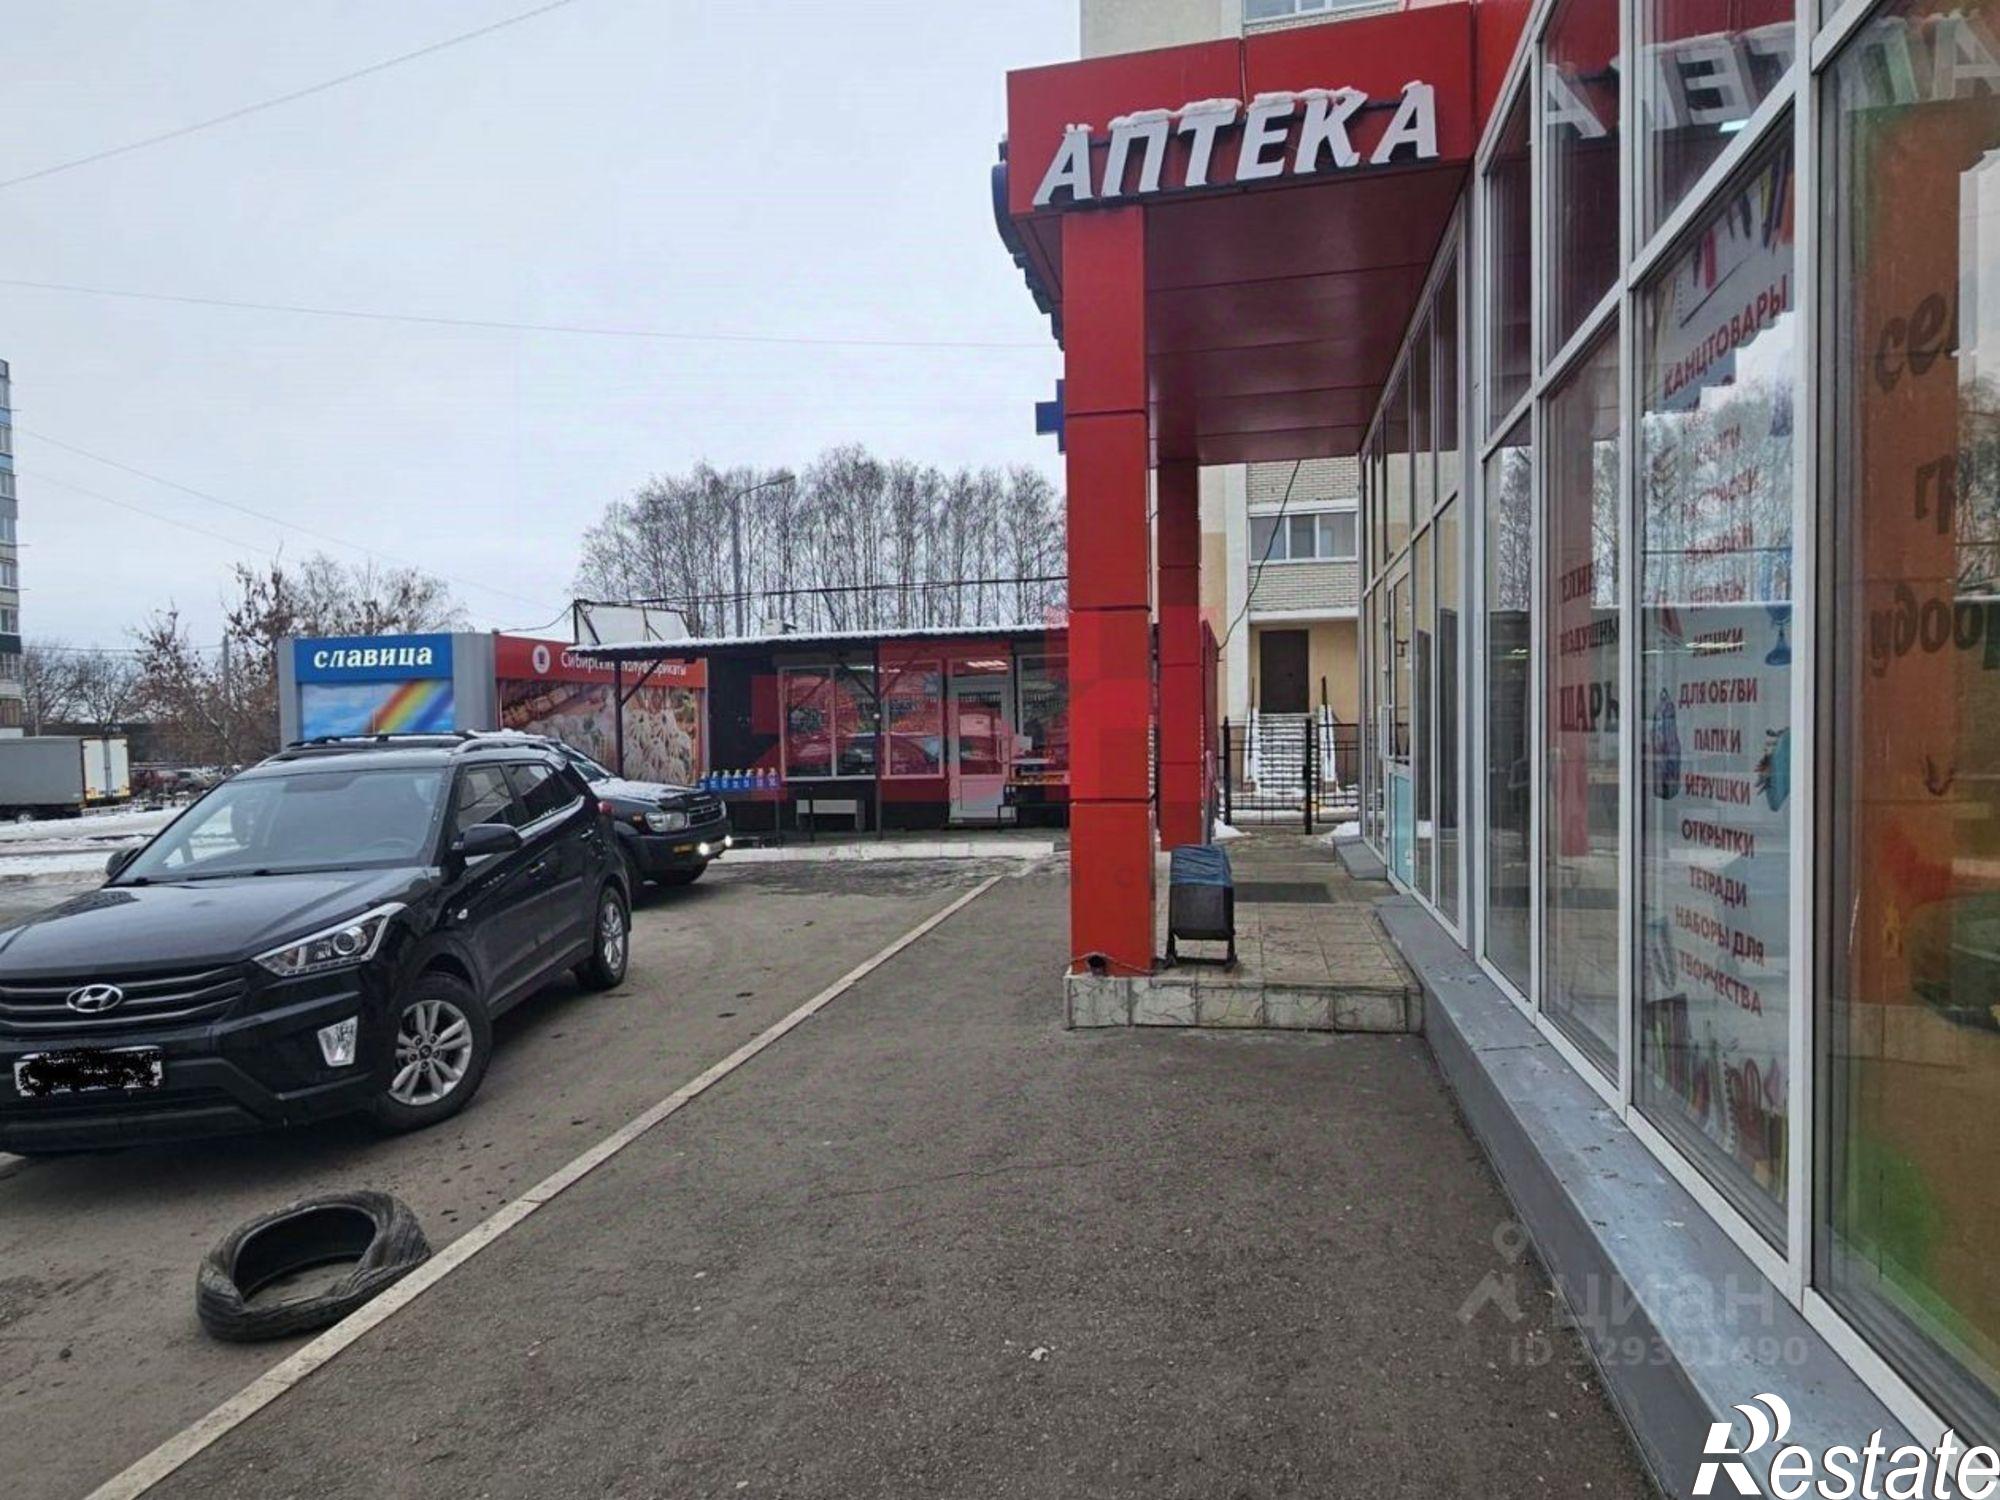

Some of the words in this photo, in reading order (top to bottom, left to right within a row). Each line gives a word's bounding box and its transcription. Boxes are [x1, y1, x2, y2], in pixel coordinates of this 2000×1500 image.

[1032, 82, 1440, 206] АПТЕКА
[1663, 274, 1788, 401] КАНЦТОВАРЫ
[313, 647, 433, 669] славица
[1694, 729, 1741, 755] ПАПКИ
[1684, 773, 1751, 806] ИГРУШКИ
[1682, 818, 1755, 860] ОТКРЫТКИ
[1689, 865, 1747, 909] ТЕТРАДИ
[1675, 905, 1730, 950] НАБОРЫ
[1731, 931, 1765, 967] ДЛЯ
[1680, 950, 1763, 1018] ТВОРЧЕСТВА
